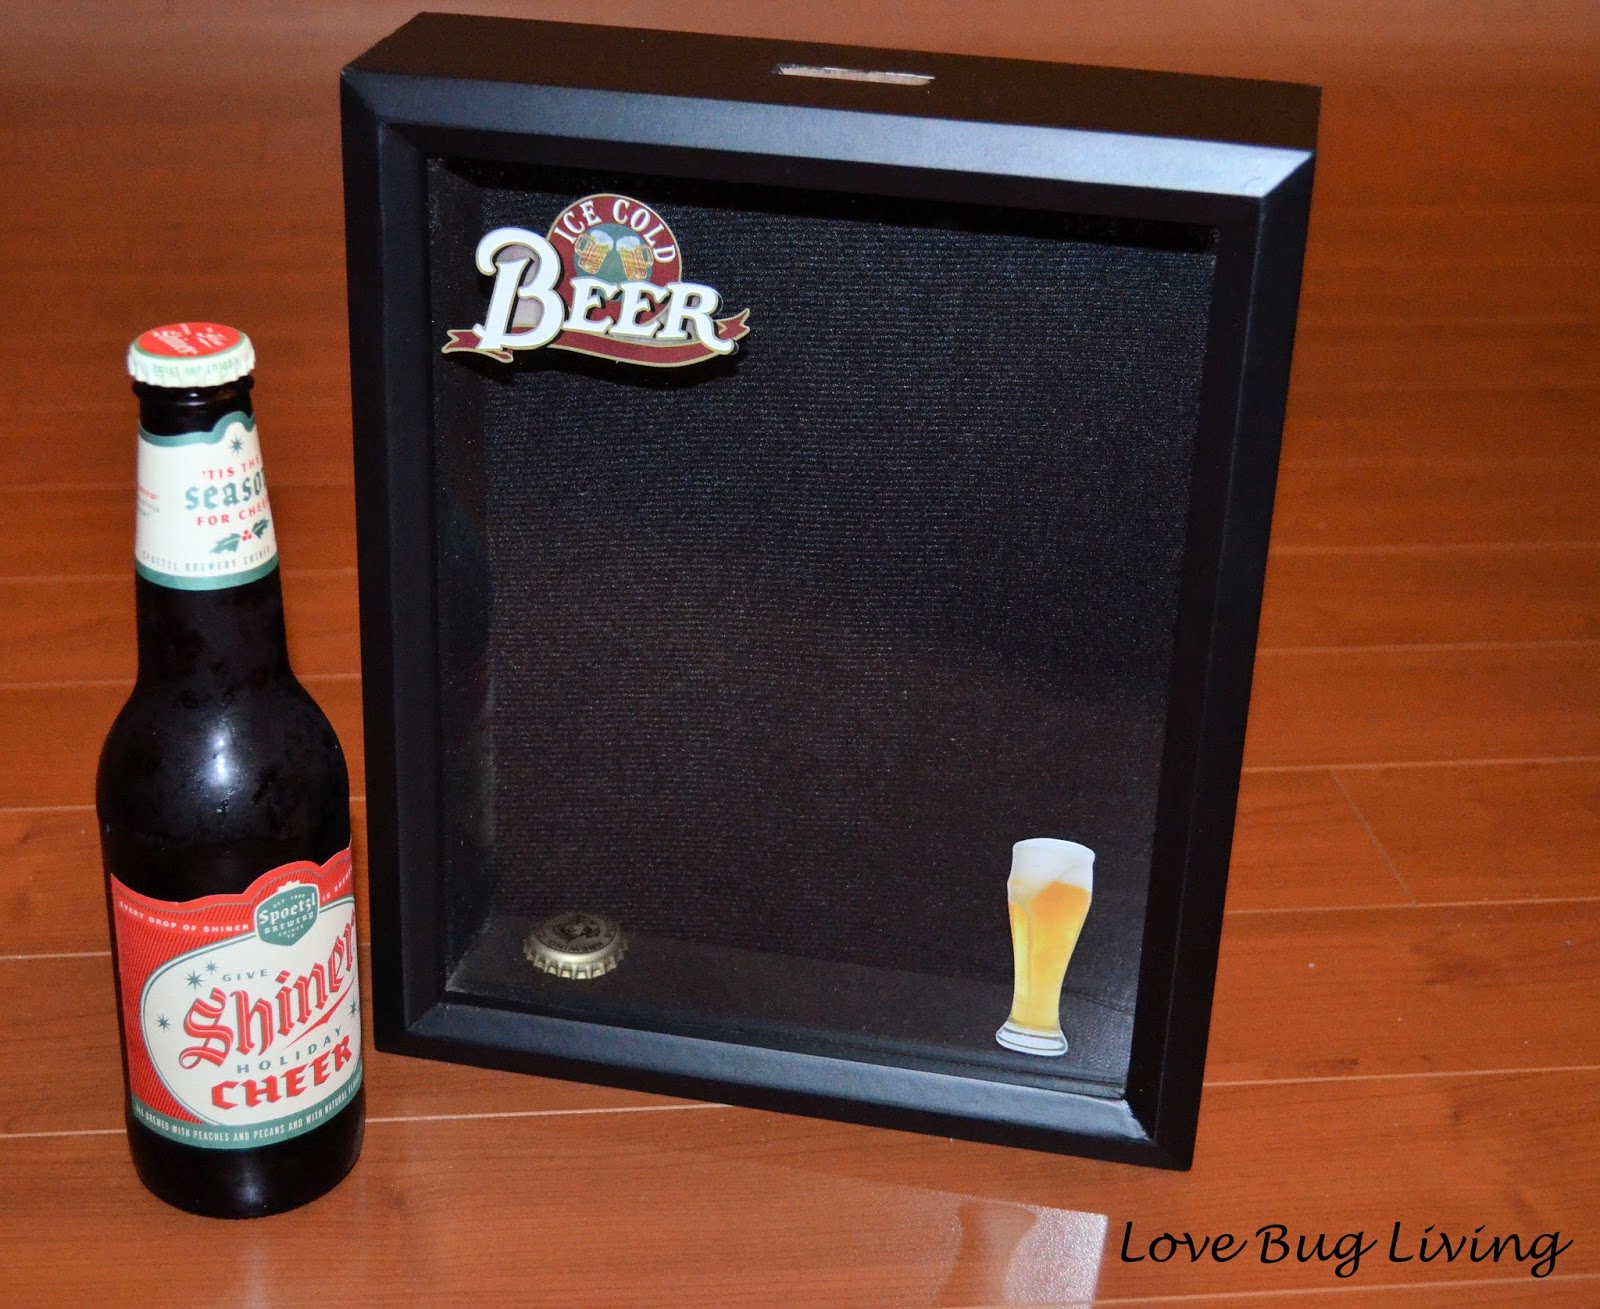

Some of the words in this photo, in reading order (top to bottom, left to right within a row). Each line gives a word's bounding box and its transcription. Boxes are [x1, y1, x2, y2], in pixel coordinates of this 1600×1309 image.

[554, 200, 602, 244] ICE
[612, 198, 677, 264] COLD
[476, 227, 736, 355] BEER
[202, 466, 235, 480] 'TIS
[241, 454, 261, 473] THE
[197, 513, 230, 526] FOR
[185, 560, 236, 572] BREWERY
[119, 900, 145, 919] EVERY
[148, 916, 177, 930] DROP
[182, 923, 198, 933] OF
[203, 923, 250, 934] SHINER
[322, 892, 331, 902] IS
[258, 891, 316, 926] Spoetzl
[264, 911, 315, 935] BREWERY
[179, 908, 356, 1070] Shiner
[222, 968, 269, 982] GIVE
[236, 1024, 343, 1074] HOLIDAY
[211, 1033, 353, 1111] CHEER
[145, 1110, 170, 1131] BREWED
[172, 1124, 190, 1137] WITH
[193, 1129, 230, 1142] PEACHES
[233, 1131, 250, 1142] AND
[253, 1124, 285, 1139] PECANS
[288, 1118, 304, 1131] AND
[305, 1110, 323, 1125] WITH
[325, 1091, 348, 1114] NATURAL
